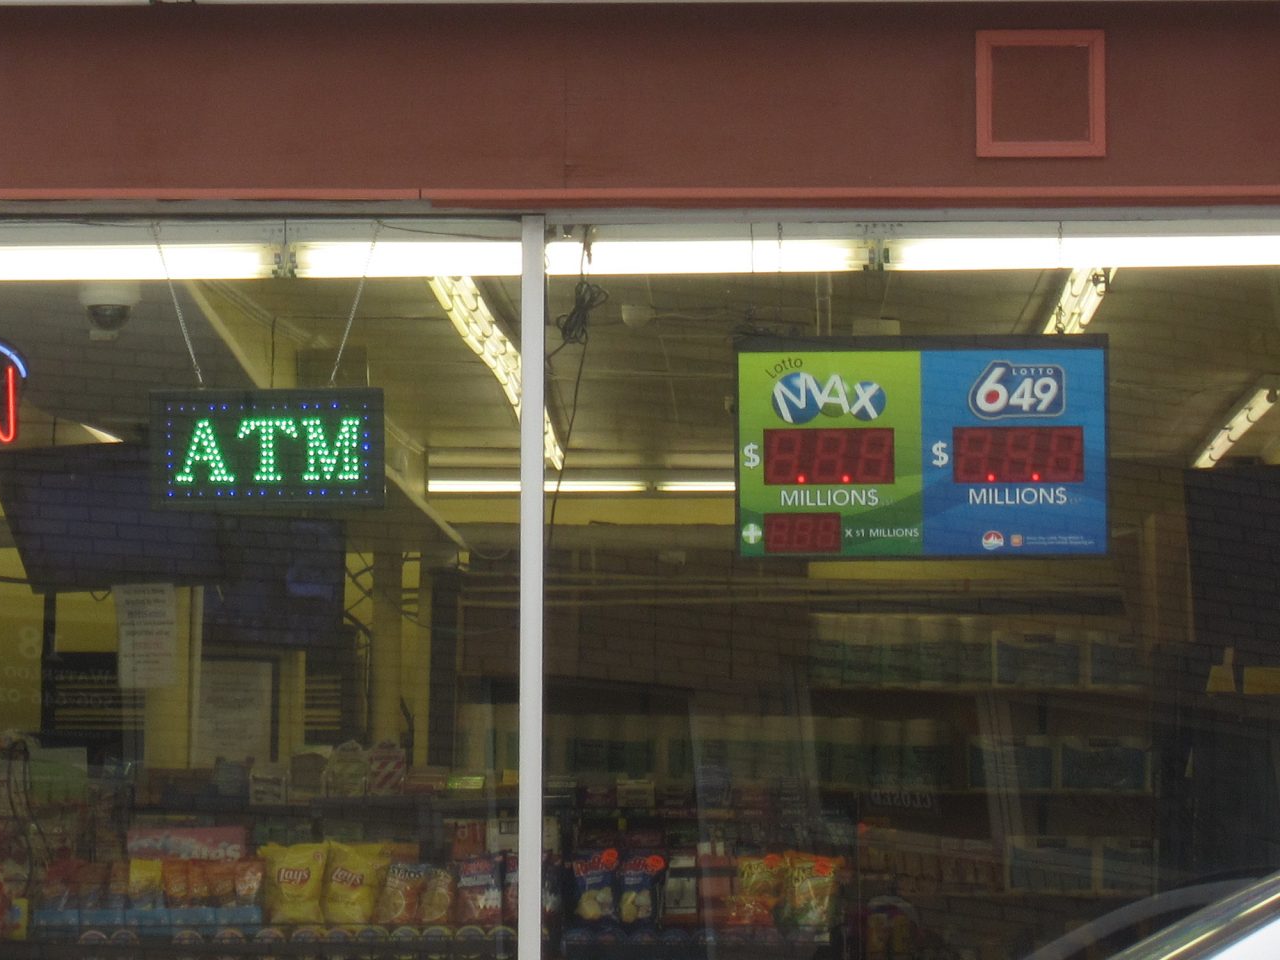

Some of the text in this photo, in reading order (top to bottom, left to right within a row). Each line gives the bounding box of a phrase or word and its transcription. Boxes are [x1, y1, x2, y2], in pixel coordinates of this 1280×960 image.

[765, 356, 804, 380] Lotto
[1012, 366, 1055, 376] LOTTO
[772, 372, 881, 424] MAX
[174, 418, 361, 484] ATM
[743, 442, 761, 470] $
[932, 441, 950, 469] $
